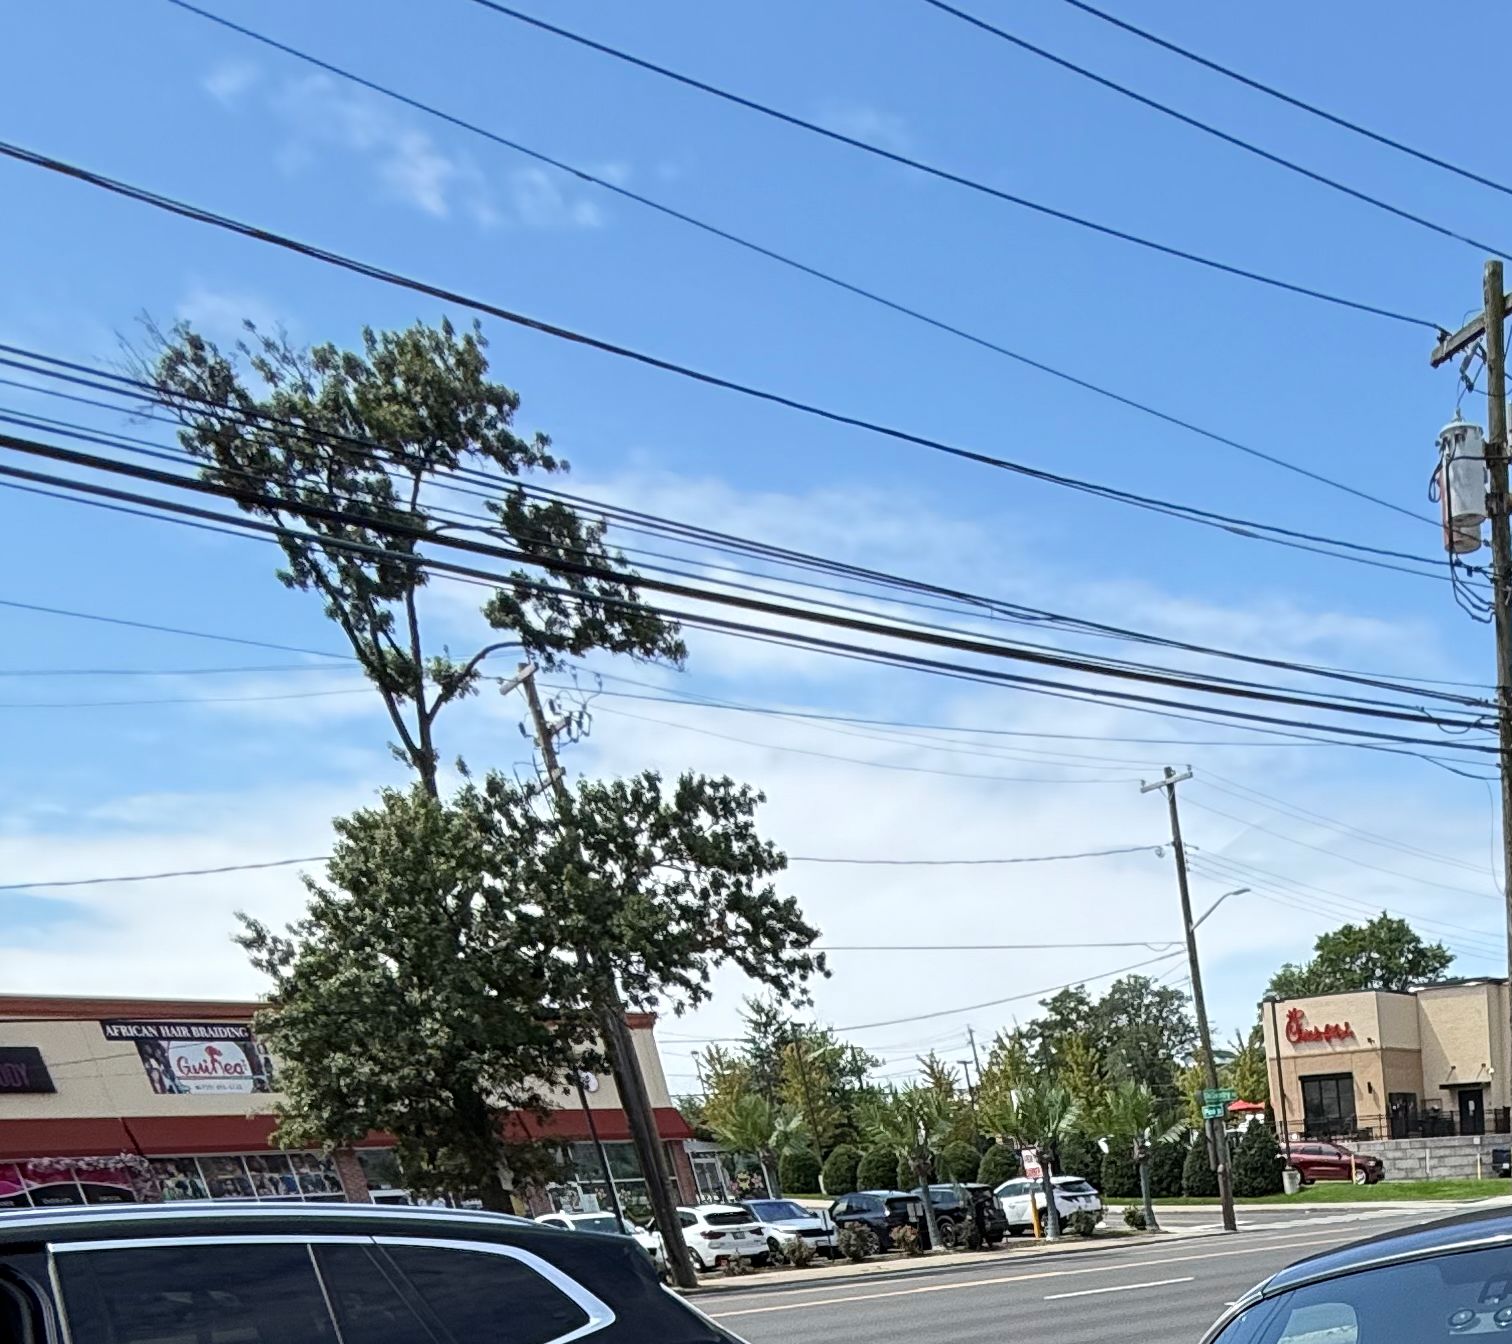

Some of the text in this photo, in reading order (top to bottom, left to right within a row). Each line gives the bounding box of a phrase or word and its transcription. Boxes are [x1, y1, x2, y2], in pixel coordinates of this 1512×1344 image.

[105, 1025, 248, 1039] AFRICAN HAIR BRAIDING
